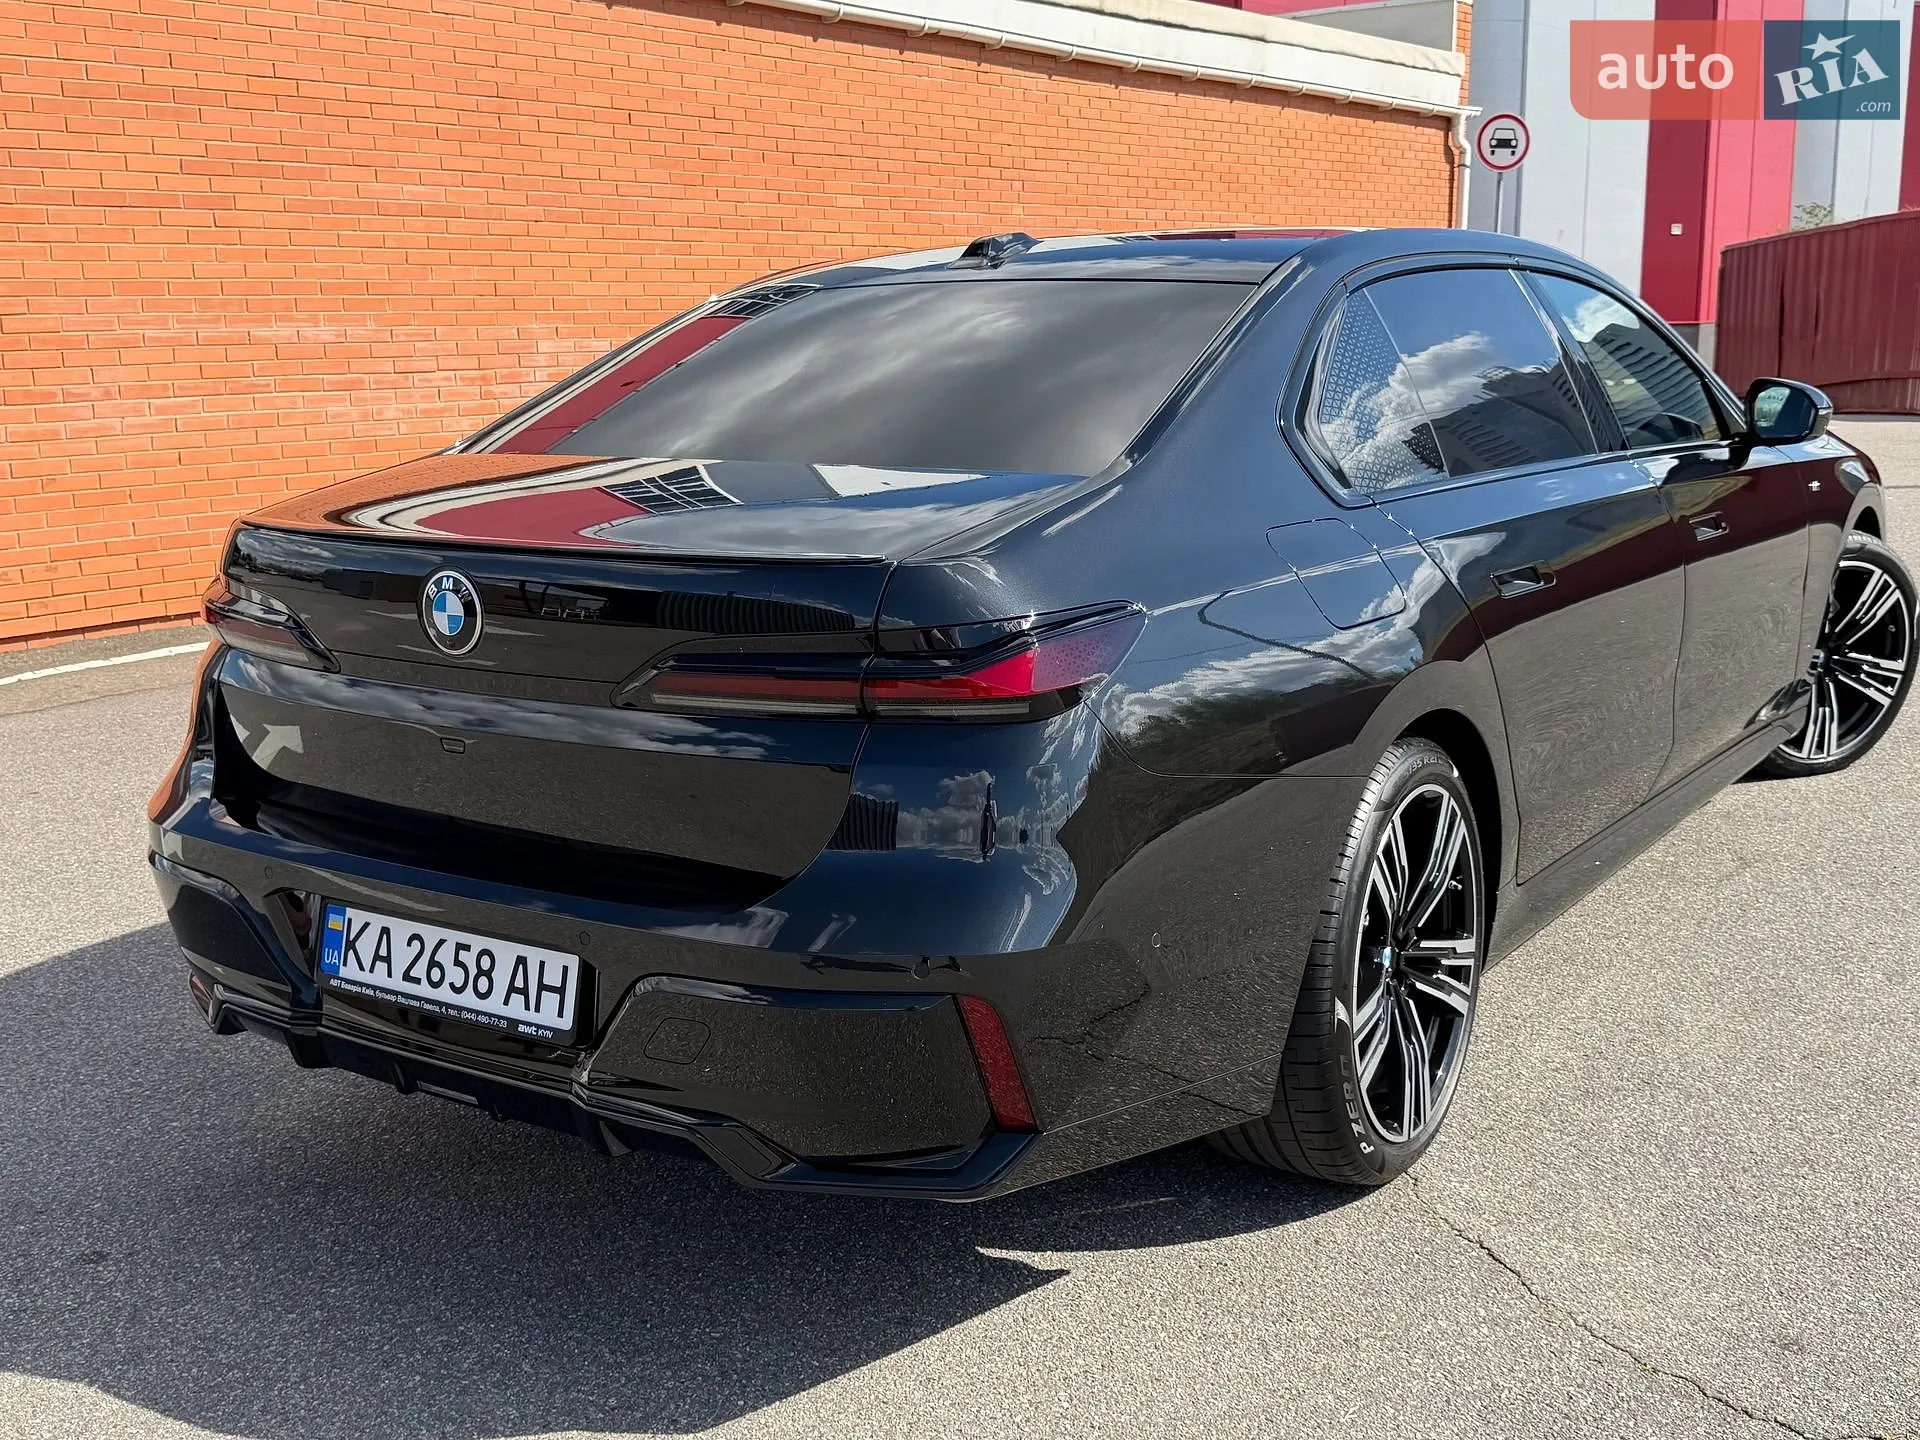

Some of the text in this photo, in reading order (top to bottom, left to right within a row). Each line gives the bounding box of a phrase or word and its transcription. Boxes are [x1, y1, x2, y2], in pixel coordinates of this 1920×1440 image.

[428, 576, 472, 603] BMW
[324, 948, 339, 966] UA
[342, 917, 569, 1019] KA 2658 AH
[538, 1028, 553, 1039] KYIV
